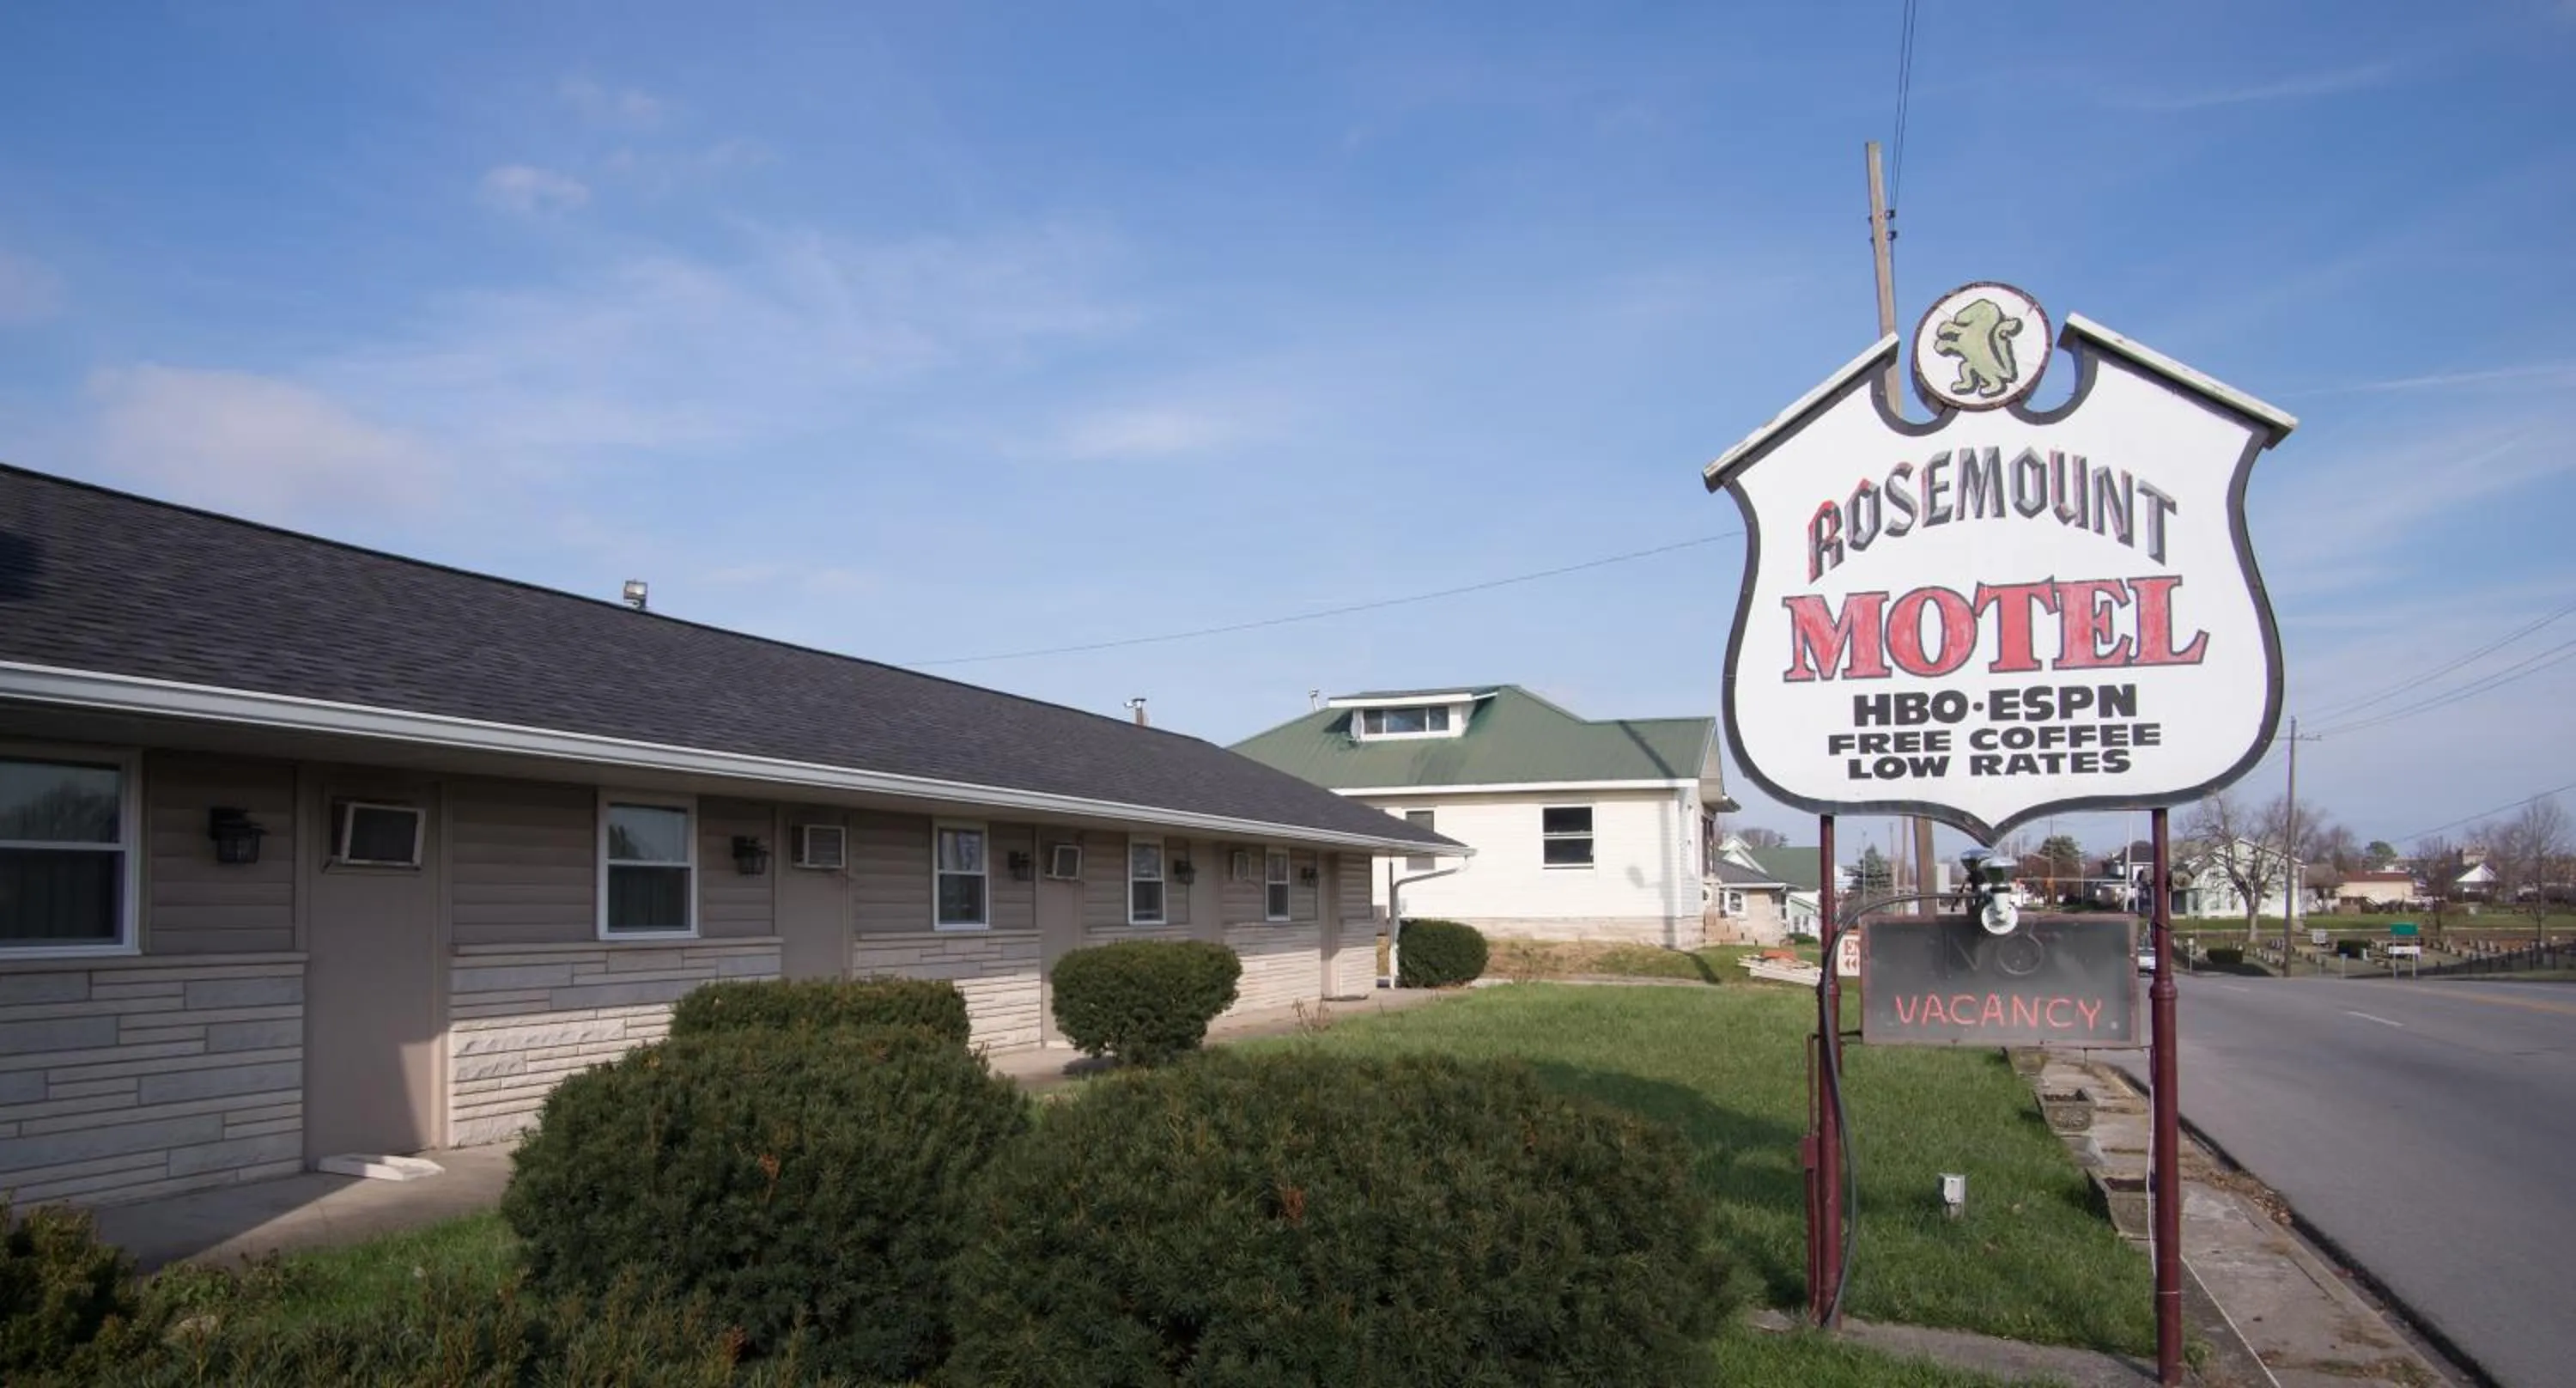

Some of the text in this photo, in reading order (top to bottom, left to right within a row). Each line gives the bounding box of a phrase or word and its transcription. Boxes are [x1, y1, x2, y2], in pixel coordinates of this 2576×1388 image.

[1807, 446, 2178, 584] ROSEMOUNT
[1782, 575, 2209, 682] MOTEL
[1828, 722, 2161, 756] FREE COFFEE
[1848, 749, 2131, 780] LOW RATES
[1894, 991, 2102, 1031] VACANCY
